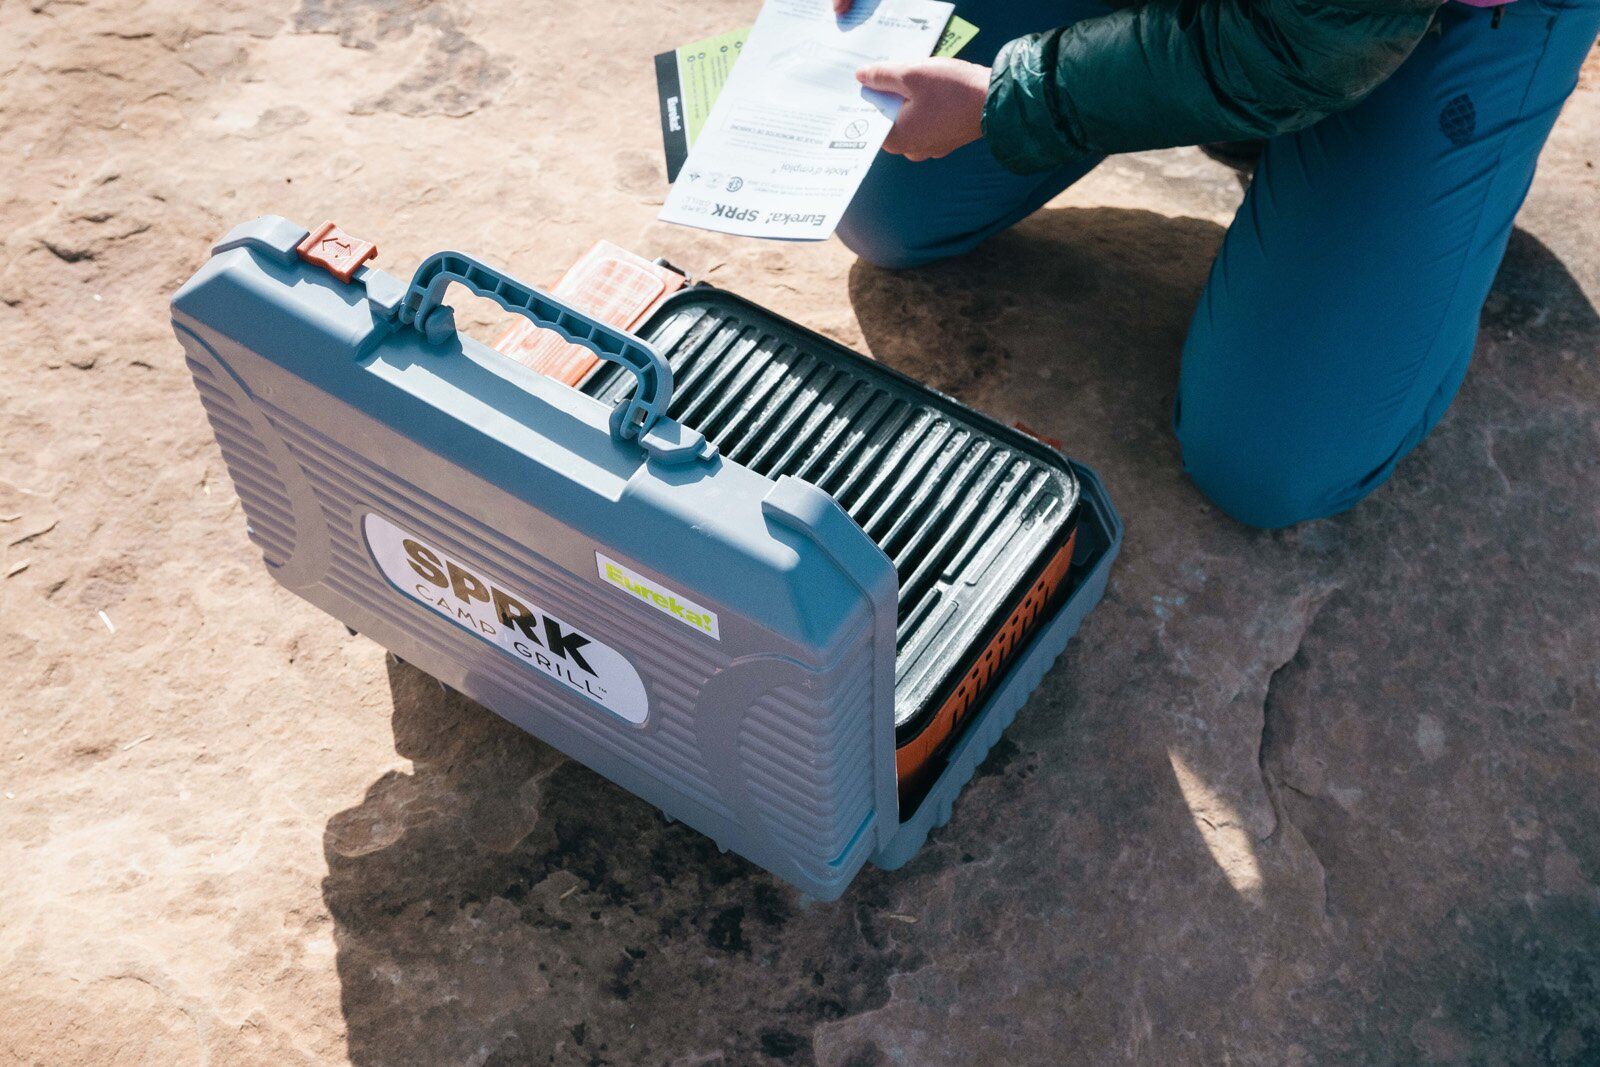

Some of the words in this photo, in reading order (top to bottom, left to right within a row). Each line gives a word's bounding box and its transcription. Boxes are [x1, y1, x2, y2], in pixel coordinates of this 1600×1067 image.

[711, 203, 761, 223] SPRK
[764, 211, 827, 227] Eureka!
[402, 538, 599, 678] SPRK
[605, 562, 712, 633] Eureka!
[414, 583, 497, 636] CAMP
[513, 641, 604, 700] GRILL
